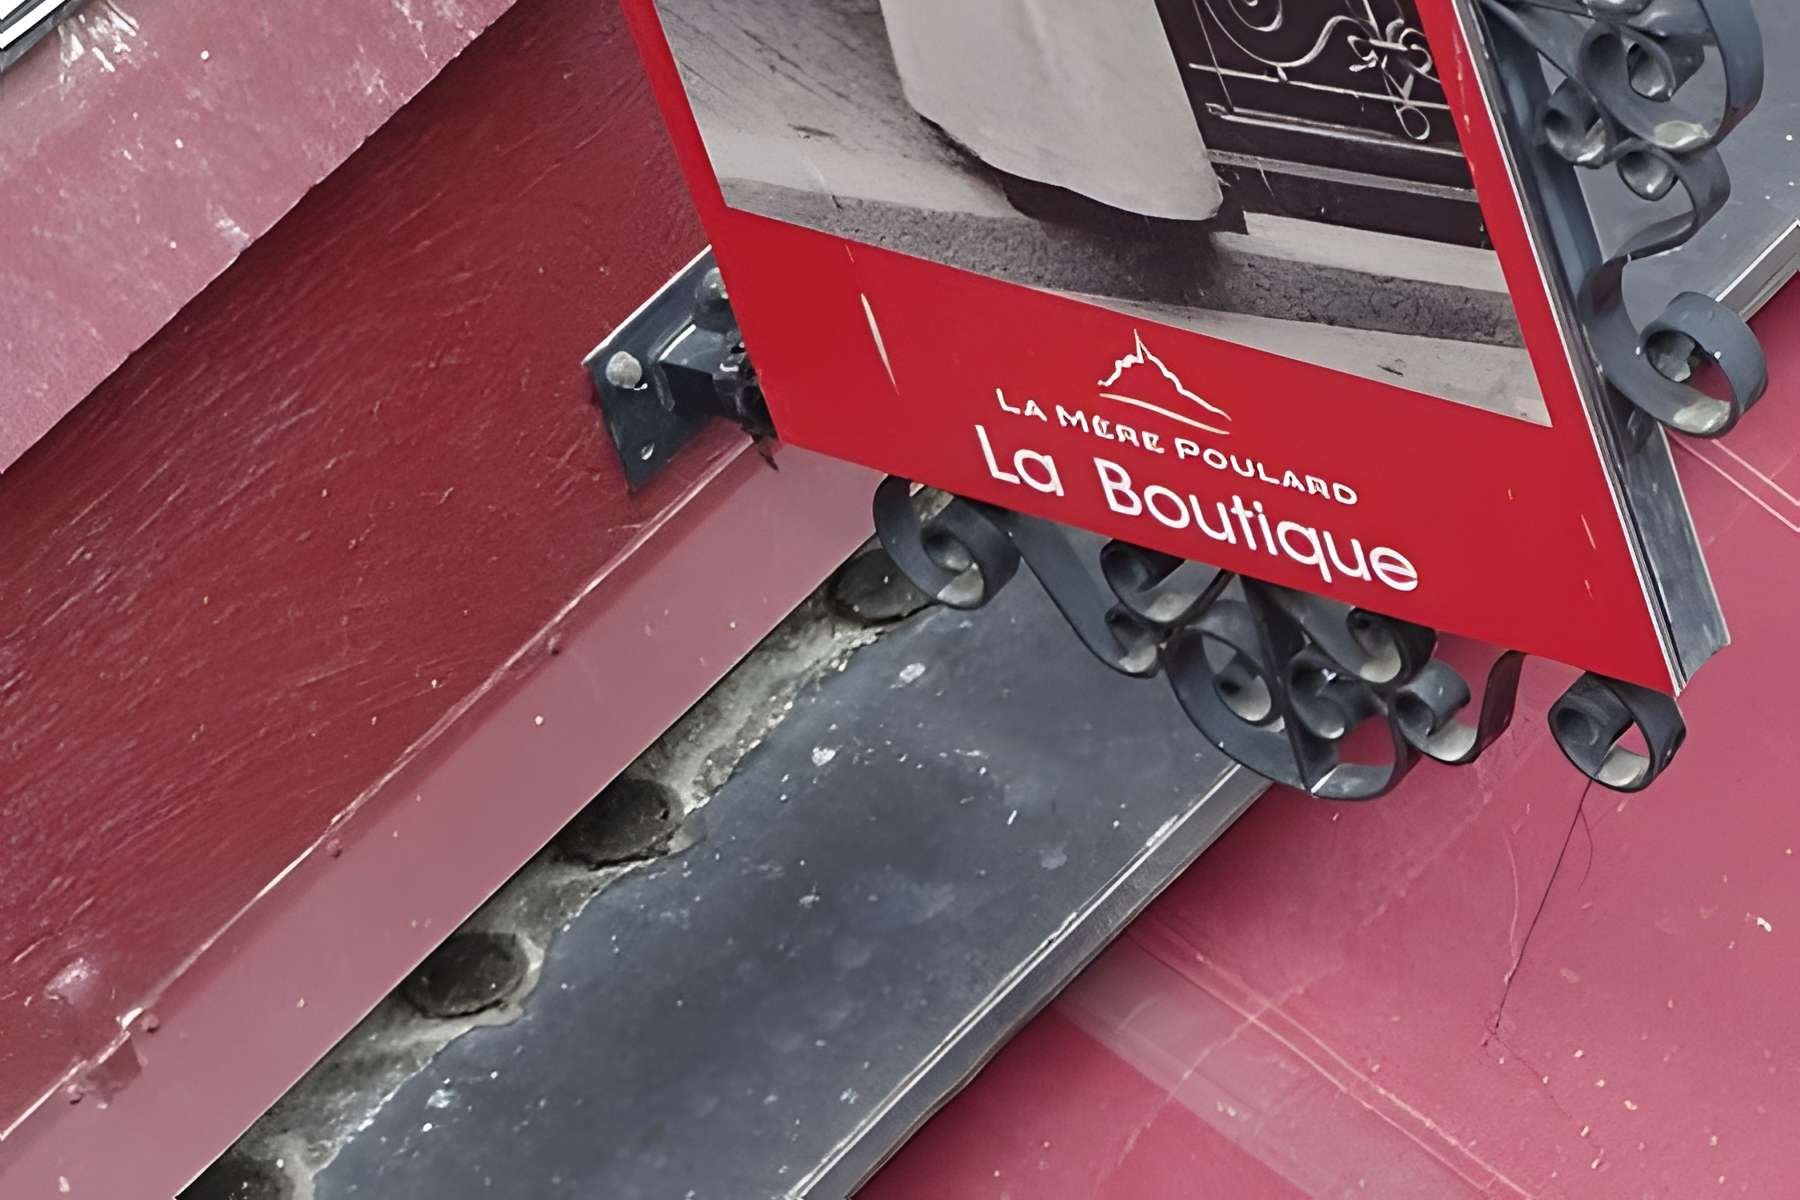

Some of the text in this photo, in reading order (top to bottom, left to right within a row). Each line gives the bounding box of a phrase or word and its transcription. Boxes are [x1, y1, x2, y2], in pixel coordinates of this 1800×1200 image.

[975, 425, 1419, 593] La Boutique
[995, 387, 1049, 423] LA
[1174, 438, 1359, 506] POULARD
